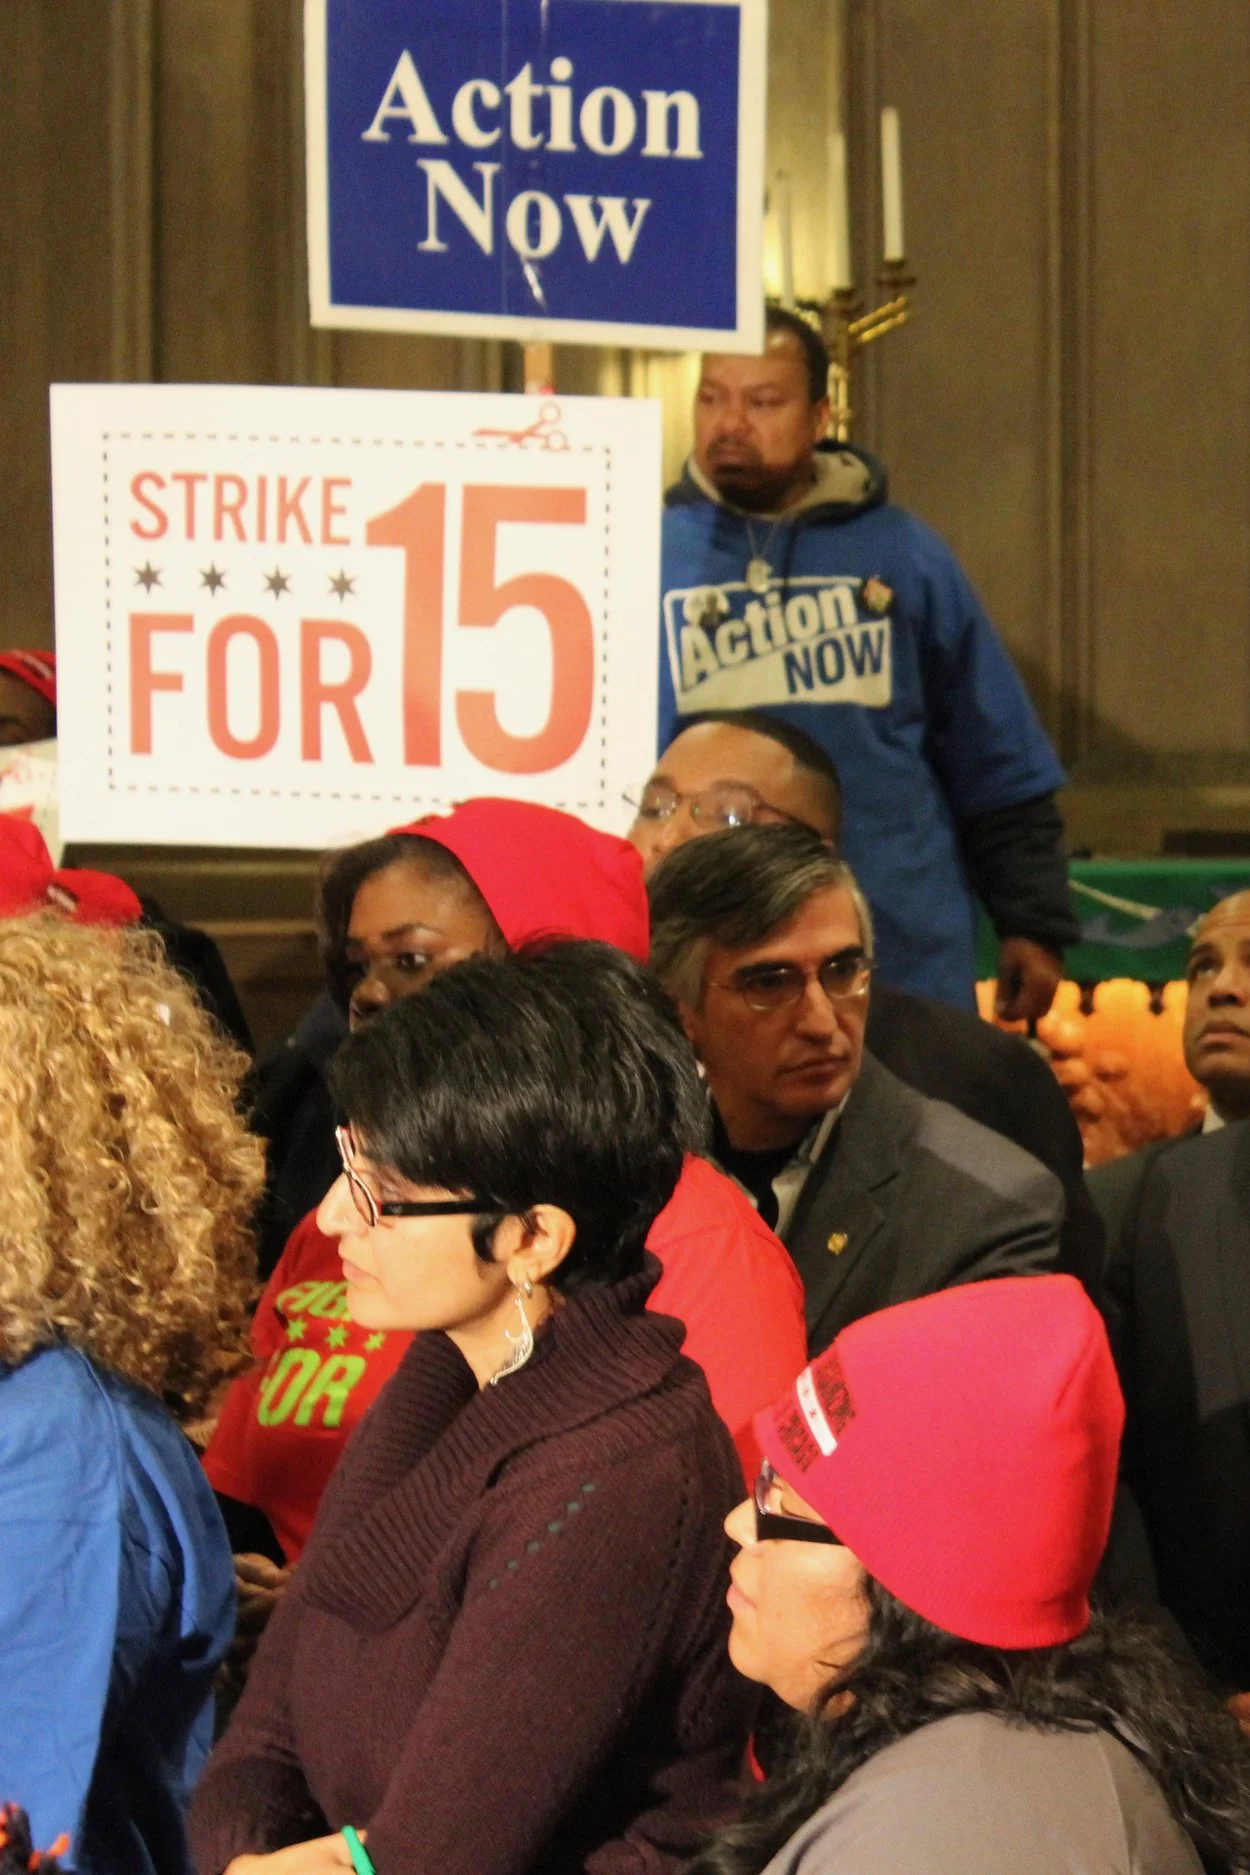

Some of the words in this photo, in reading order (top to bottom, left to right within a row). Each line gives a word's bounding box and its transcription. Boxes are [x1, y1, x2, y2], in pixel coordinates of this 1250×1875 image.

[361, 48, 704, 159] Action
[416, 158, 651, 265] Now
[129, 470, 353, 546] STRIKE
[129, 612, 375, 765] FOR
[365, 481, 595, 776] 15
[681, 583, 859, 694] Action
[784, 628, 885, 694] NOW
[257, 1346, 366, 1428] OR
